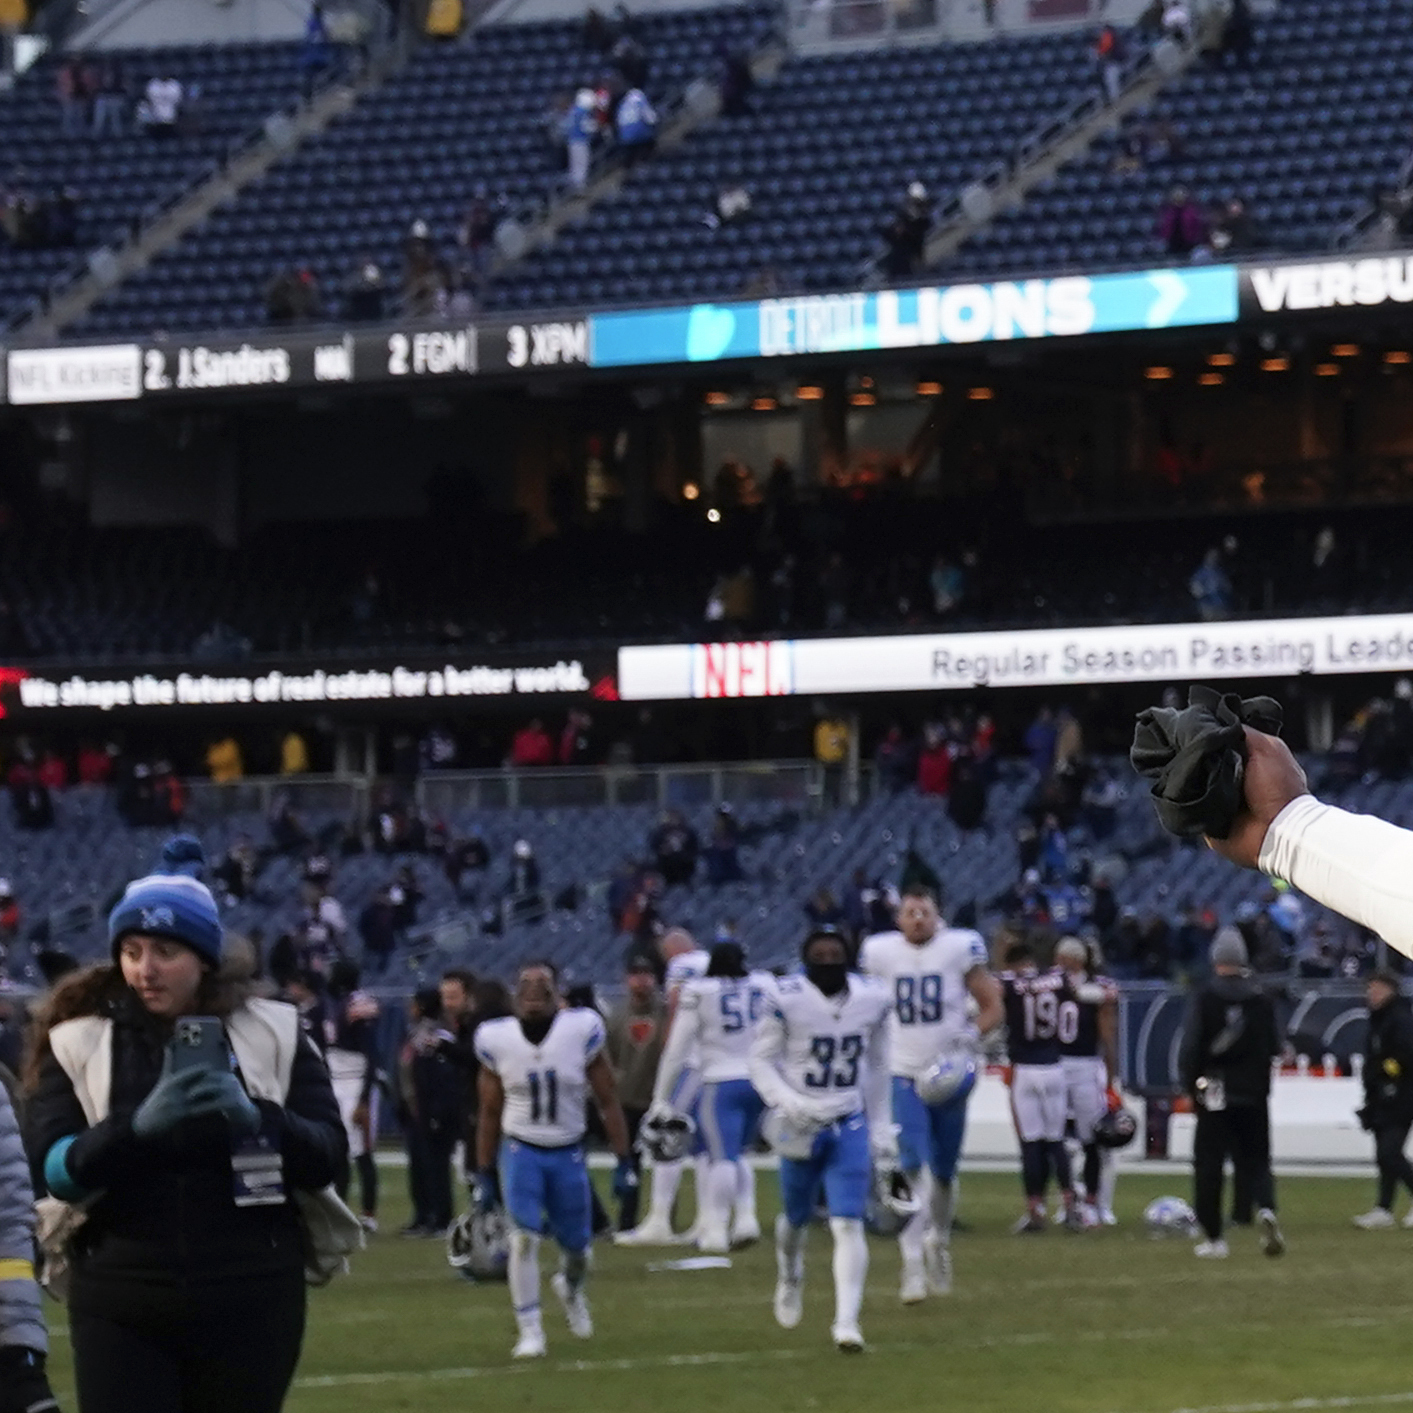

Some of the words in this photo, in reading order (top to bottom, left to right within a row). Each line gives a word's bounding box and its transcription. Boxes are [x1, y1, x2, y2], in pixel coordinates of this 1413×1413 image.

[758, 292, 867, 358] DETROIT
[876, 274, 1097, 348] LIONS
[387, 332, 410, 376] 2
[506, 324, 529, 368] 3
[931, 645, 1050, 686] Regular
[1062, 641, 1179, 673] Season
[1187, 636, 1316, 676] Passing
[20, 677, 59, 707] We
[59, 675, 132, 711] shape
[132, 673, 175, 705] the
[176, 671, 252, 704] future
[252, 669, 280, 703] of
[281, 668, 325, 701] real
[325, 668, 392, 700] estate
[391, 665, 426, 698] for
[427, 670, 444, 697] a
[444, 663, 513, 697] better
[1022, 991, 1058, 1041] 19
[526, 1068, 558, 1123] 11
